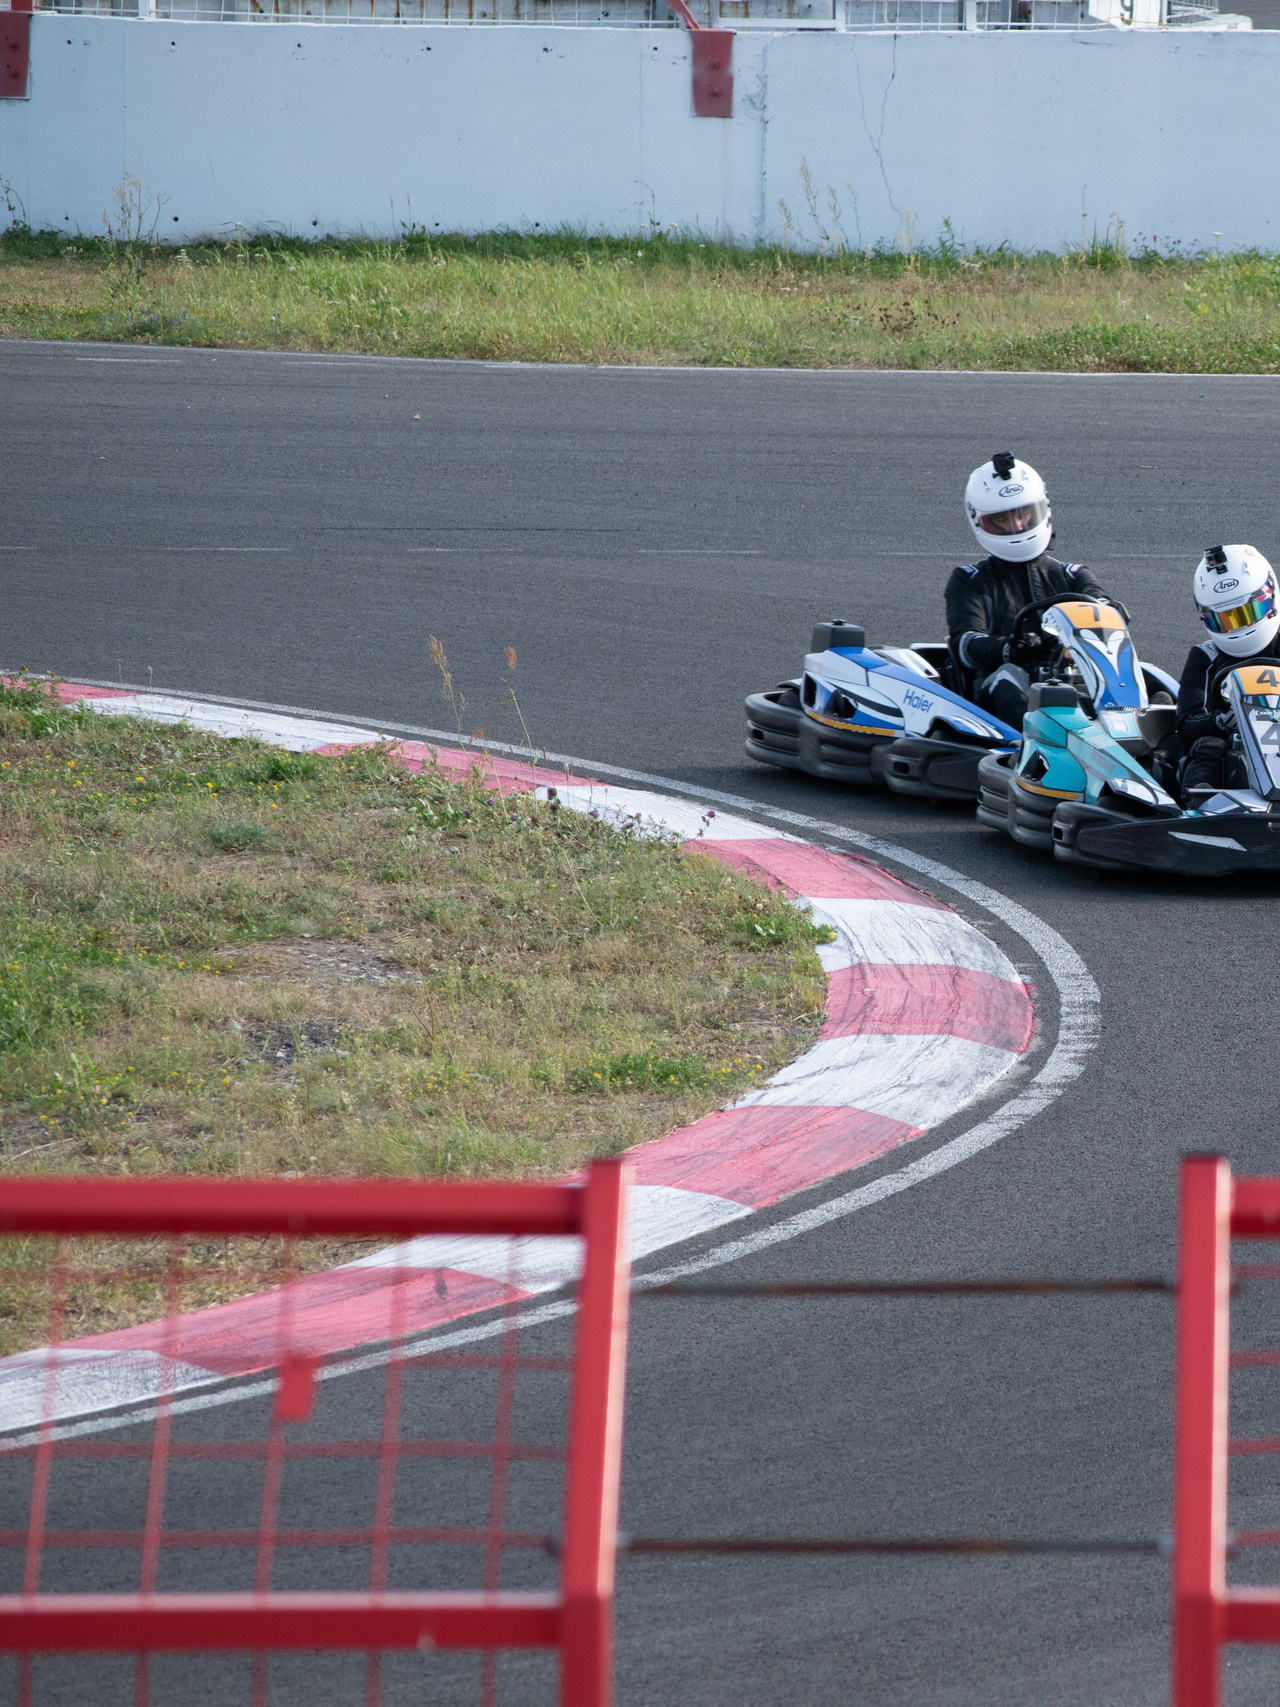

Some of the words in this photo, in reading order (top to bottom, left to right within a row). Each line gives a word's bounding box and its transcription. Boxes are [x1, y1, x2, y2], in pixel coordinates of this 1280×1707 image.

[1078, 604, 1101, 622] 7
[1256, 669, 1280, 687] 4
[902, 689, 934, 713] Haier
